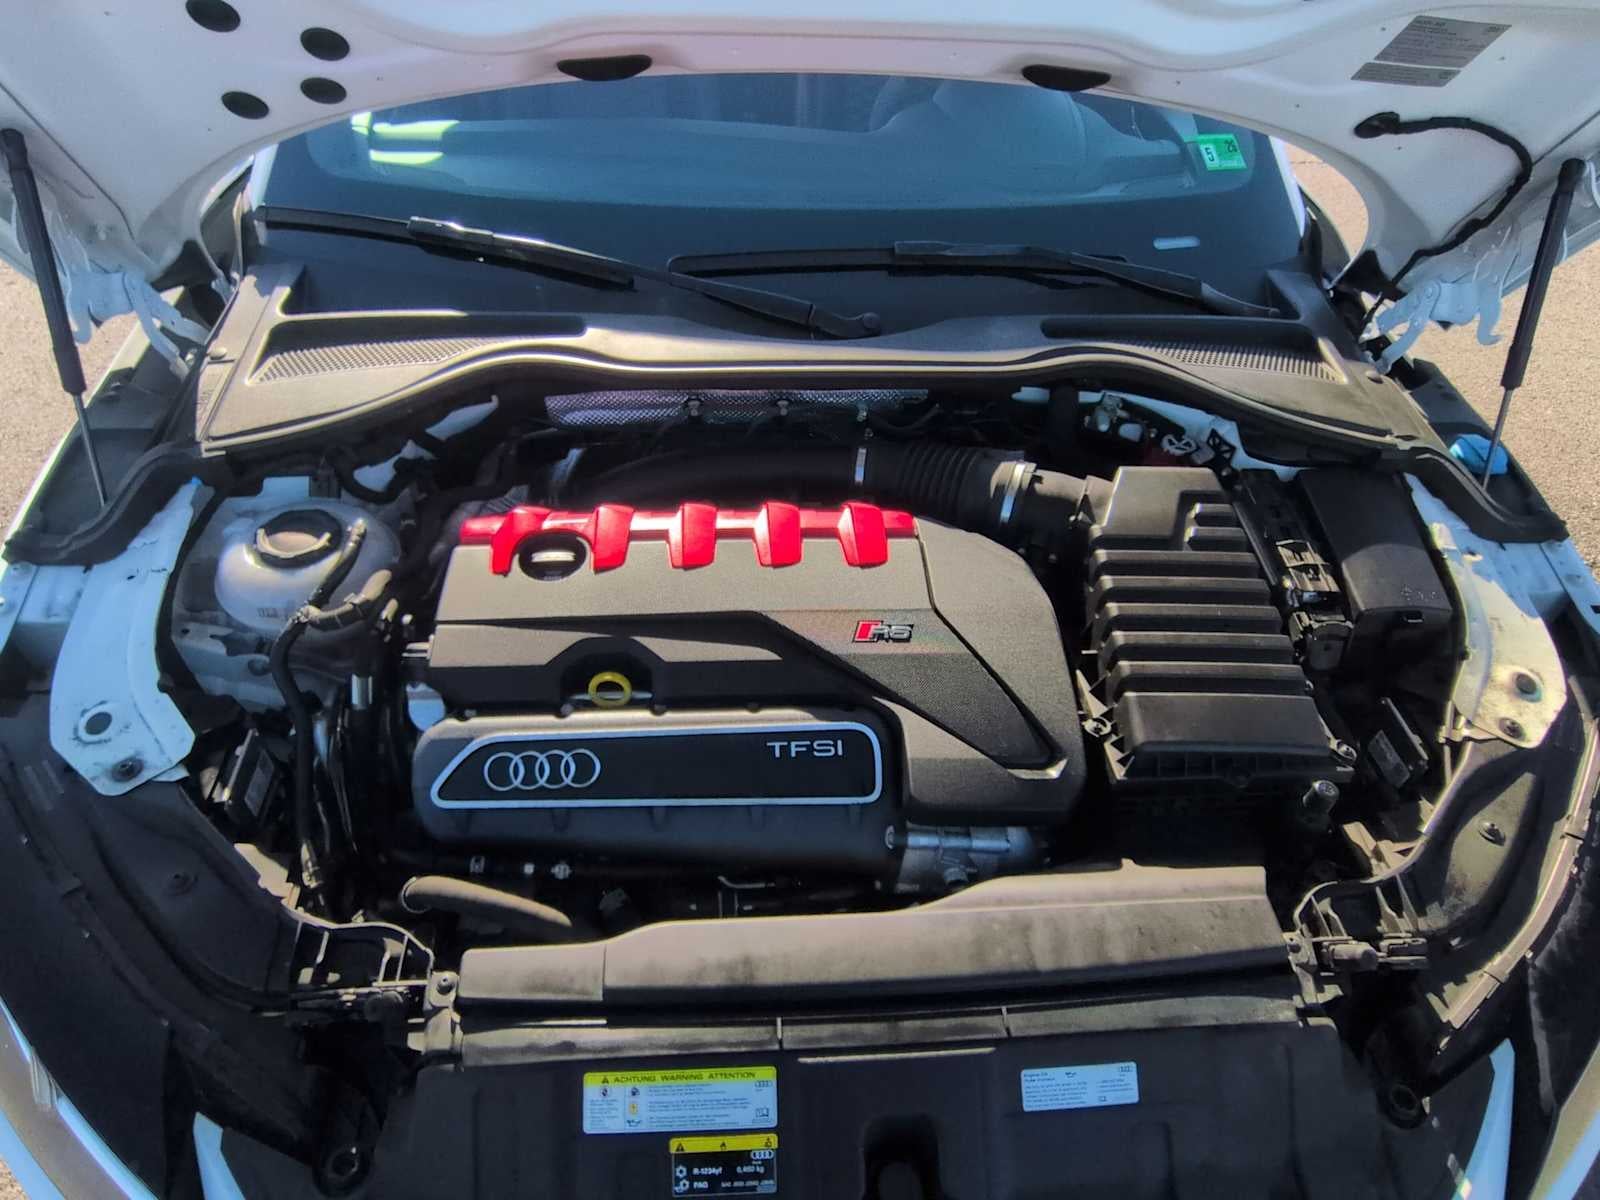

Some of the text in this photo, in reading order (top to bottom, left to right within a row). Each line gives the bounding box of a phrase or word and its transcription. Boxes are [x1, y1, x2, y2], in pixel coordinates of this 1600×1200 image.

[1204, 147, 1215, 162] 5
[766, 739, 843, 758] TFSI
[614, 1071, 756, 1084] ACHTUNG WARNING ATTENTION
